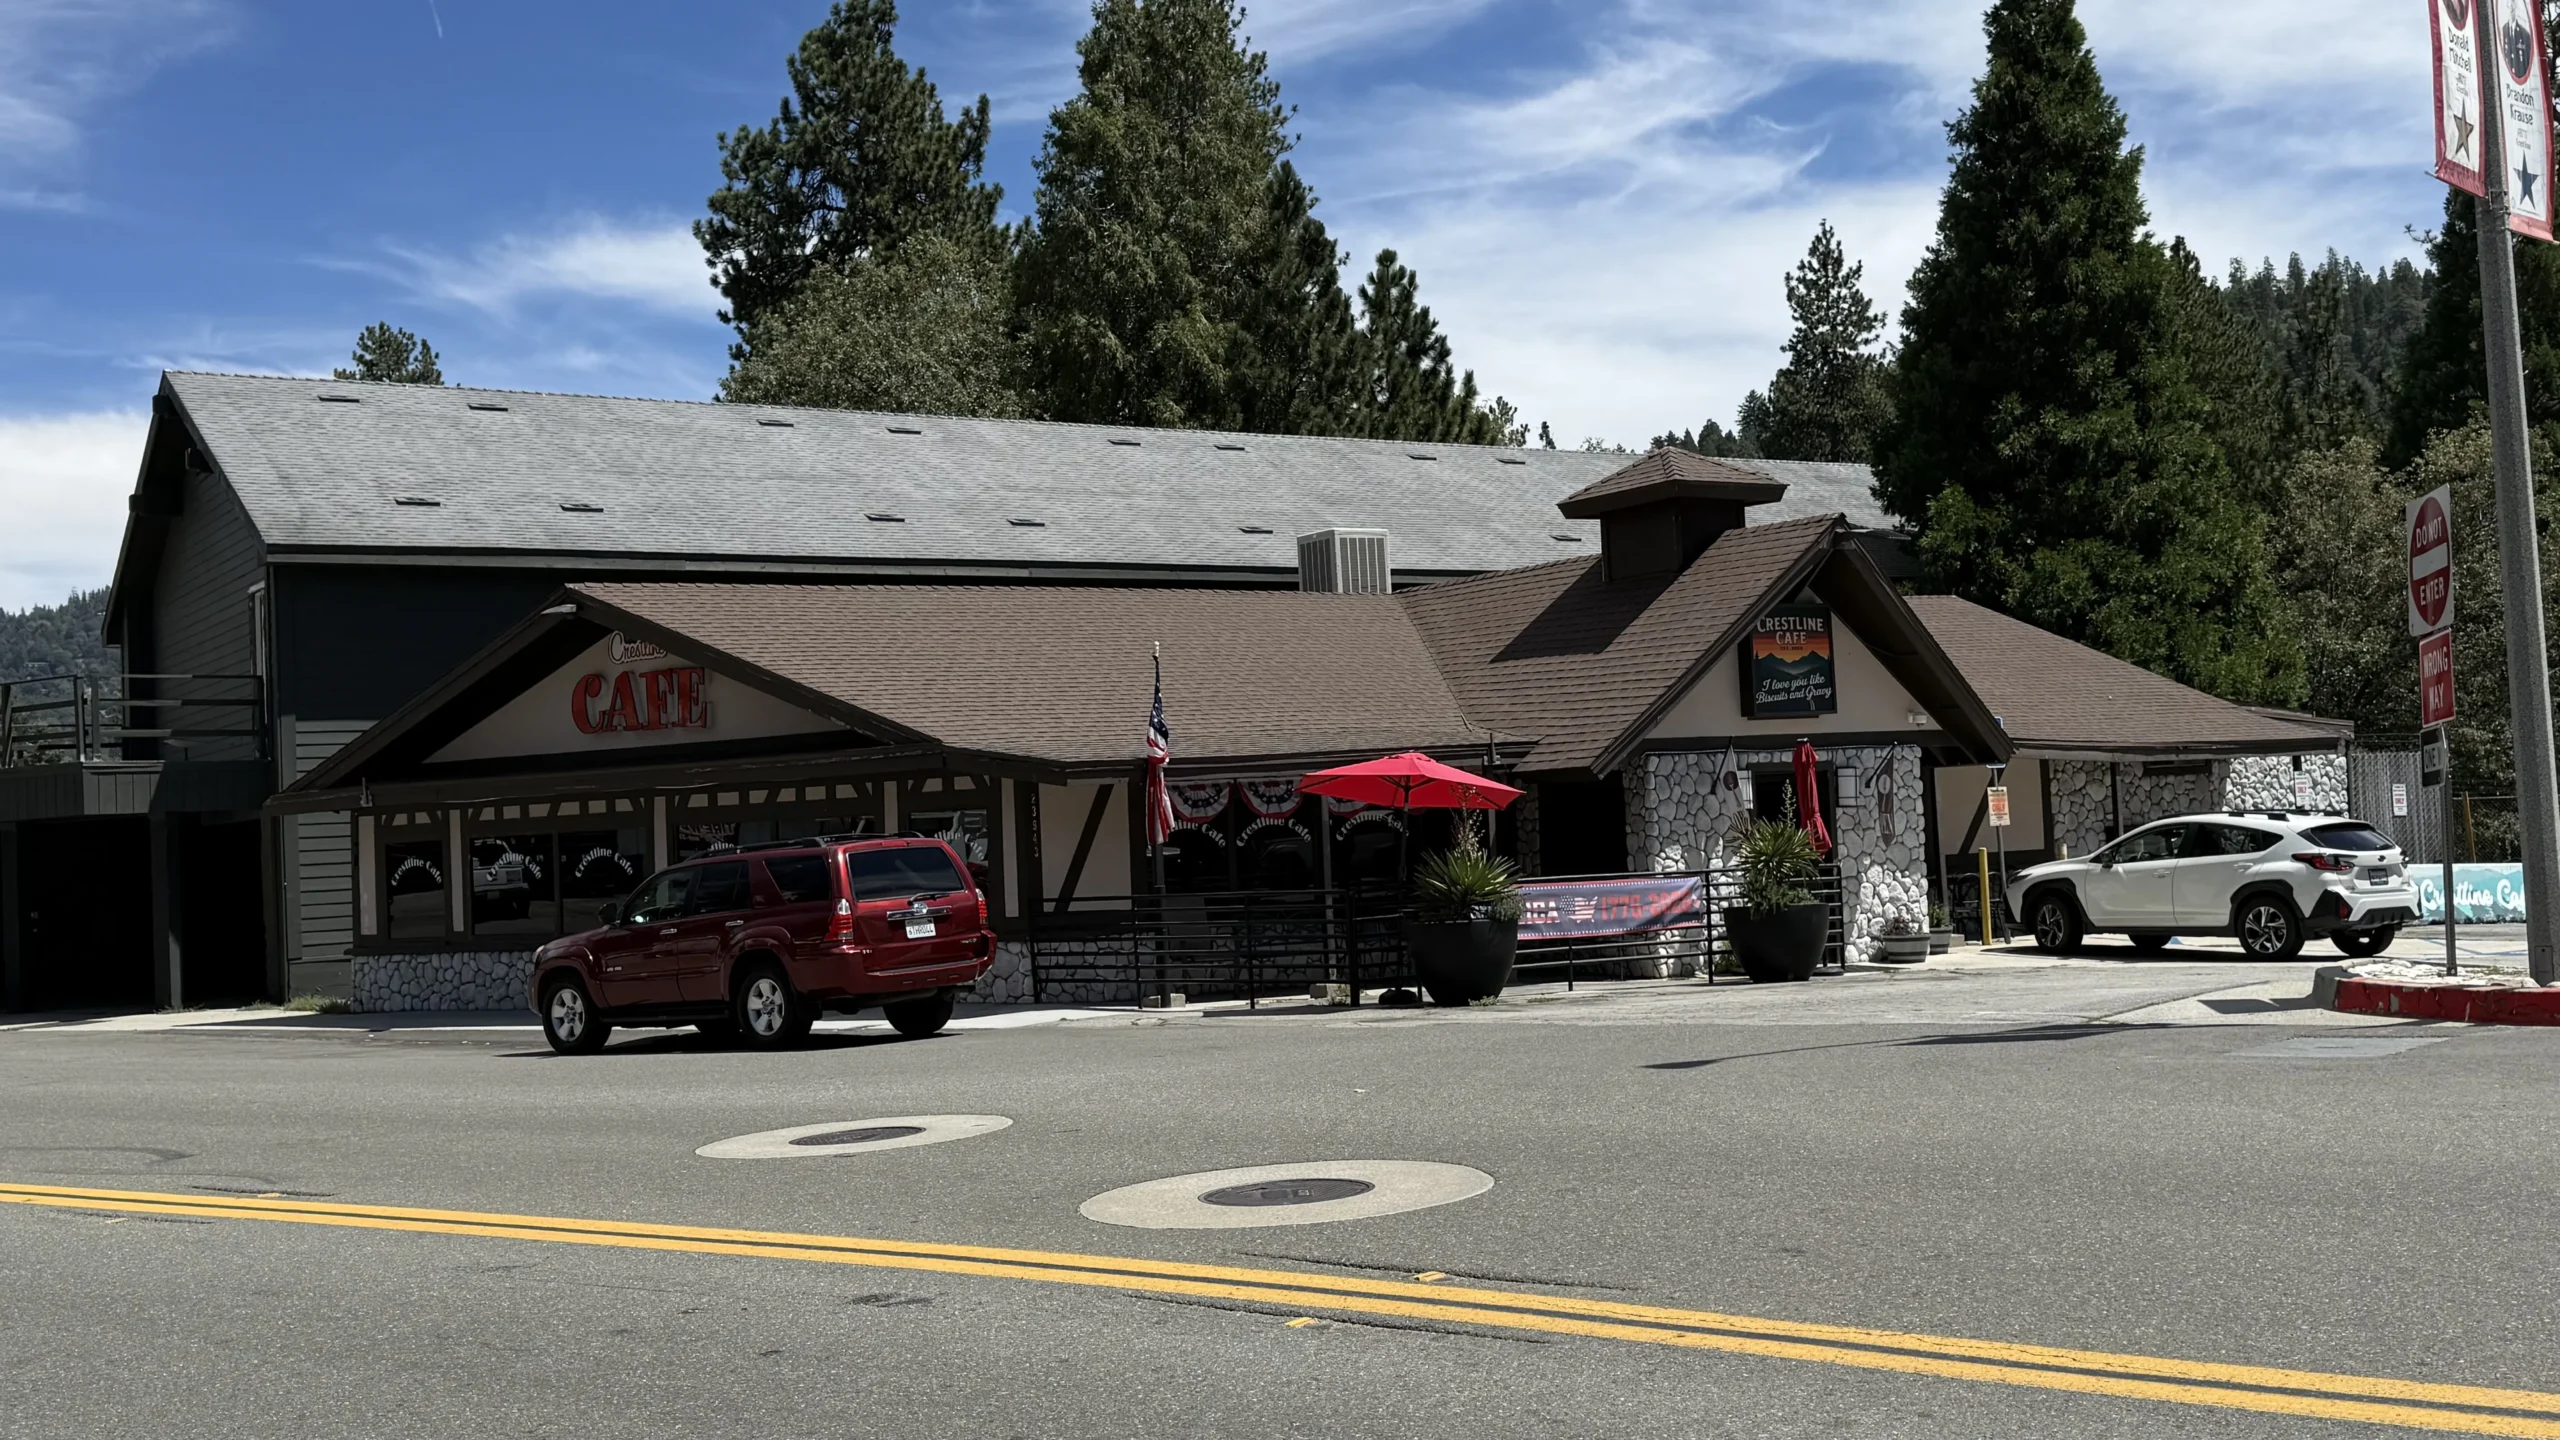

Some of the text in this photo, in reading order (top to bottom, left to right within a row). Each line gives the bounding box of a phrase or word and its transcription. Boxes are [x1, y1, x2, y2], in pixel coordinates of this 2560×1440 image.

[2448, 26, 2469, 52] Donald
[2506, 83, 2535, 108] Brandon
[2510, 103, 2534, 125] Krause
[2416, 516, 2442, 548] DO NOT
[2420, 577, 2445, 605] ENTER
[1757, 616, 1824, 633] CRESTLINE
[1776, 632, 1807, 645] CAFE
[2423, 646, 2448, 678] WRONG
[1756, 685, 1832, 704] Biscuits and Gravy
[1762, 673, 1825, 691] I love you like
[571, 667, 708, 734] CAFE
[2429, 682, 2444, 711] WAY
[1201, 823, 1227, 848] Cafe
[1236, 817, 1312, 847] Crestline Cafe
[391, 857, 442, 887] Crestline Cafe
[486, 852, 542, 881] Crestline Cafe
[575, 846, 634, 878] Crestline Cafe
[2420, 879, 2494, 911] Crtline
